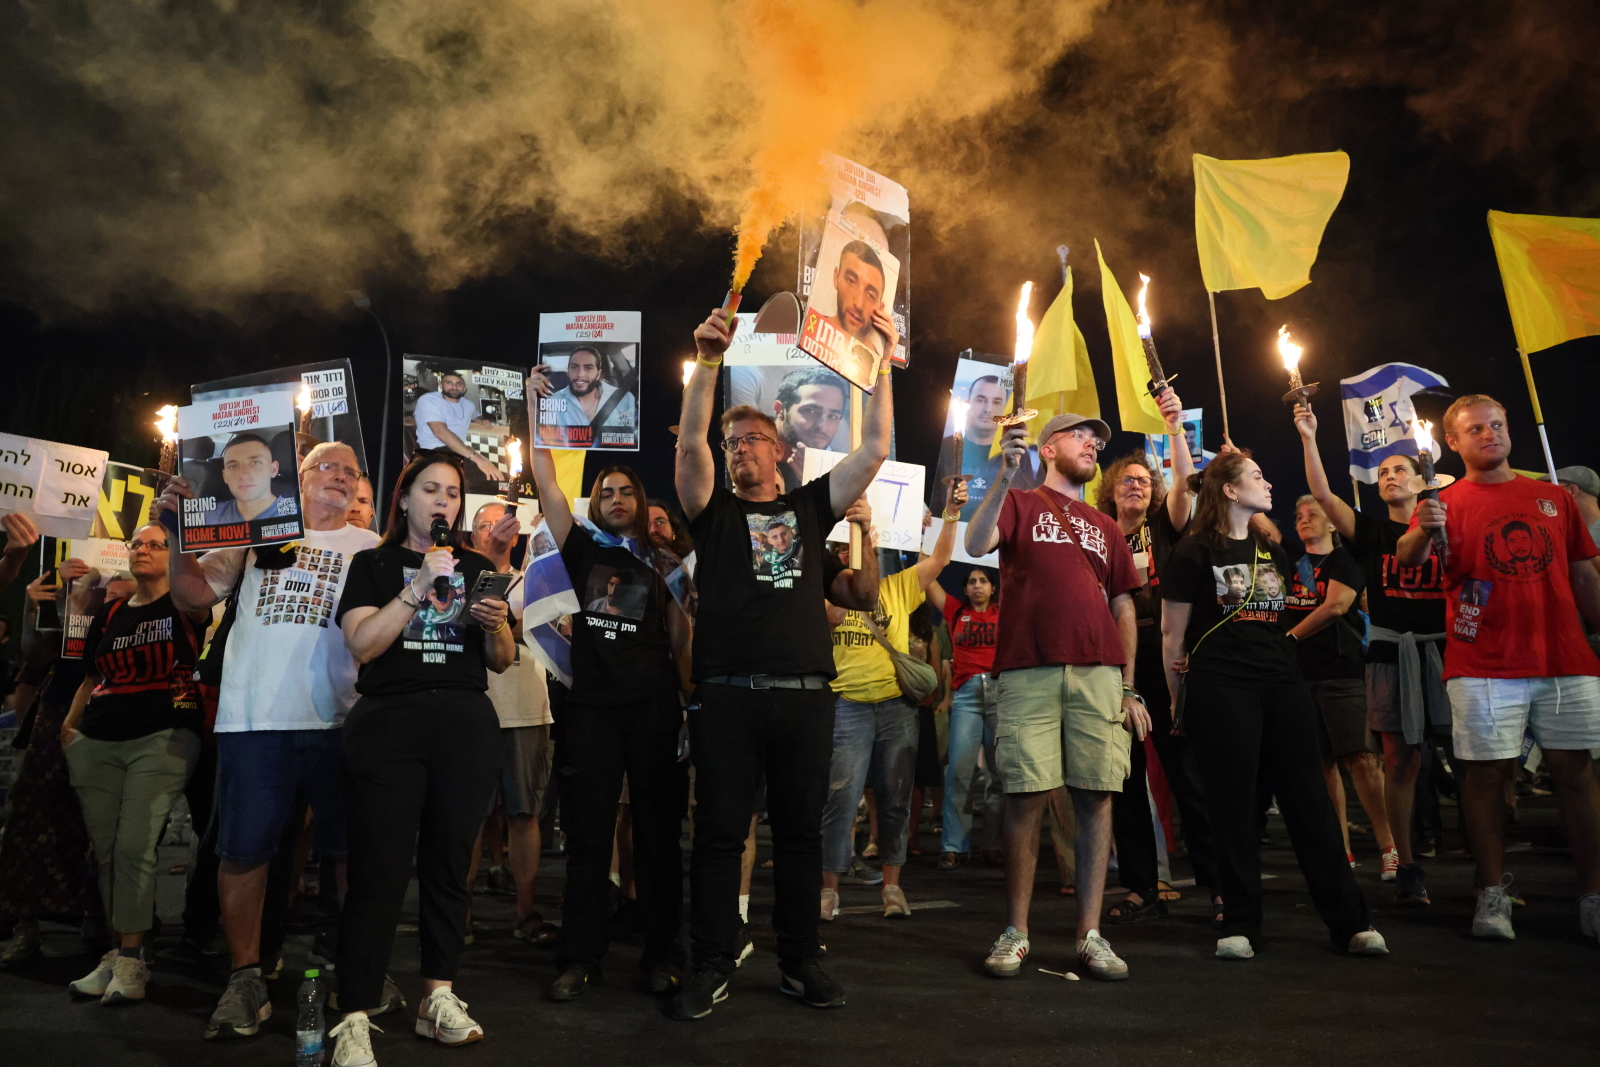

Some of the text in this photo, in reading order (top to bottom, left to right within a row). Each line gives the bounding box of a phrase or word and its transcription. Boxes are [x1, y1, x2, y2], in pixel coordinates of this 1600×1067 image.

[858, 179, 881, 197] ANGREST
[304, 372, 343, 385] דרור אור
[474, 376, 521, 388] SEGEV KALFON
[311, 386, 344, 400] ROR OR
[540, 398, 567, 412] BRING
[212, 406, 260, 421] MATAN ANGREST
[539, 411, 557, 425] HIM
[539, 426, 593, 441] HOME NOW!
[0, 449, 98, 478] אסור לה
[0, 482, 90, 508] את הח
[184, 496, 217, 512] BRING
[184, 511, 206, 527] HIM
[185, 522, 251, 543] HOME NOW!
[262, 527, 282, 538] FAMILIES
[773, 578, 793, 589] NOW!
[1459, 604, 1481, 617] END
[136, 616, 173, 634] מחזירים
[585, 616, 637, 633] מתן צנגאוקר
[1454, 623, 1477, 638] WAR
[68, 626, 86, 638] HIM
[604, 631, 617, 640] 25
[113, 628, 173, 651] אותם הביתה
[403, 641, 464, 652] BRING MATAN HOME
[422, 653, 446, 664] NOW!
